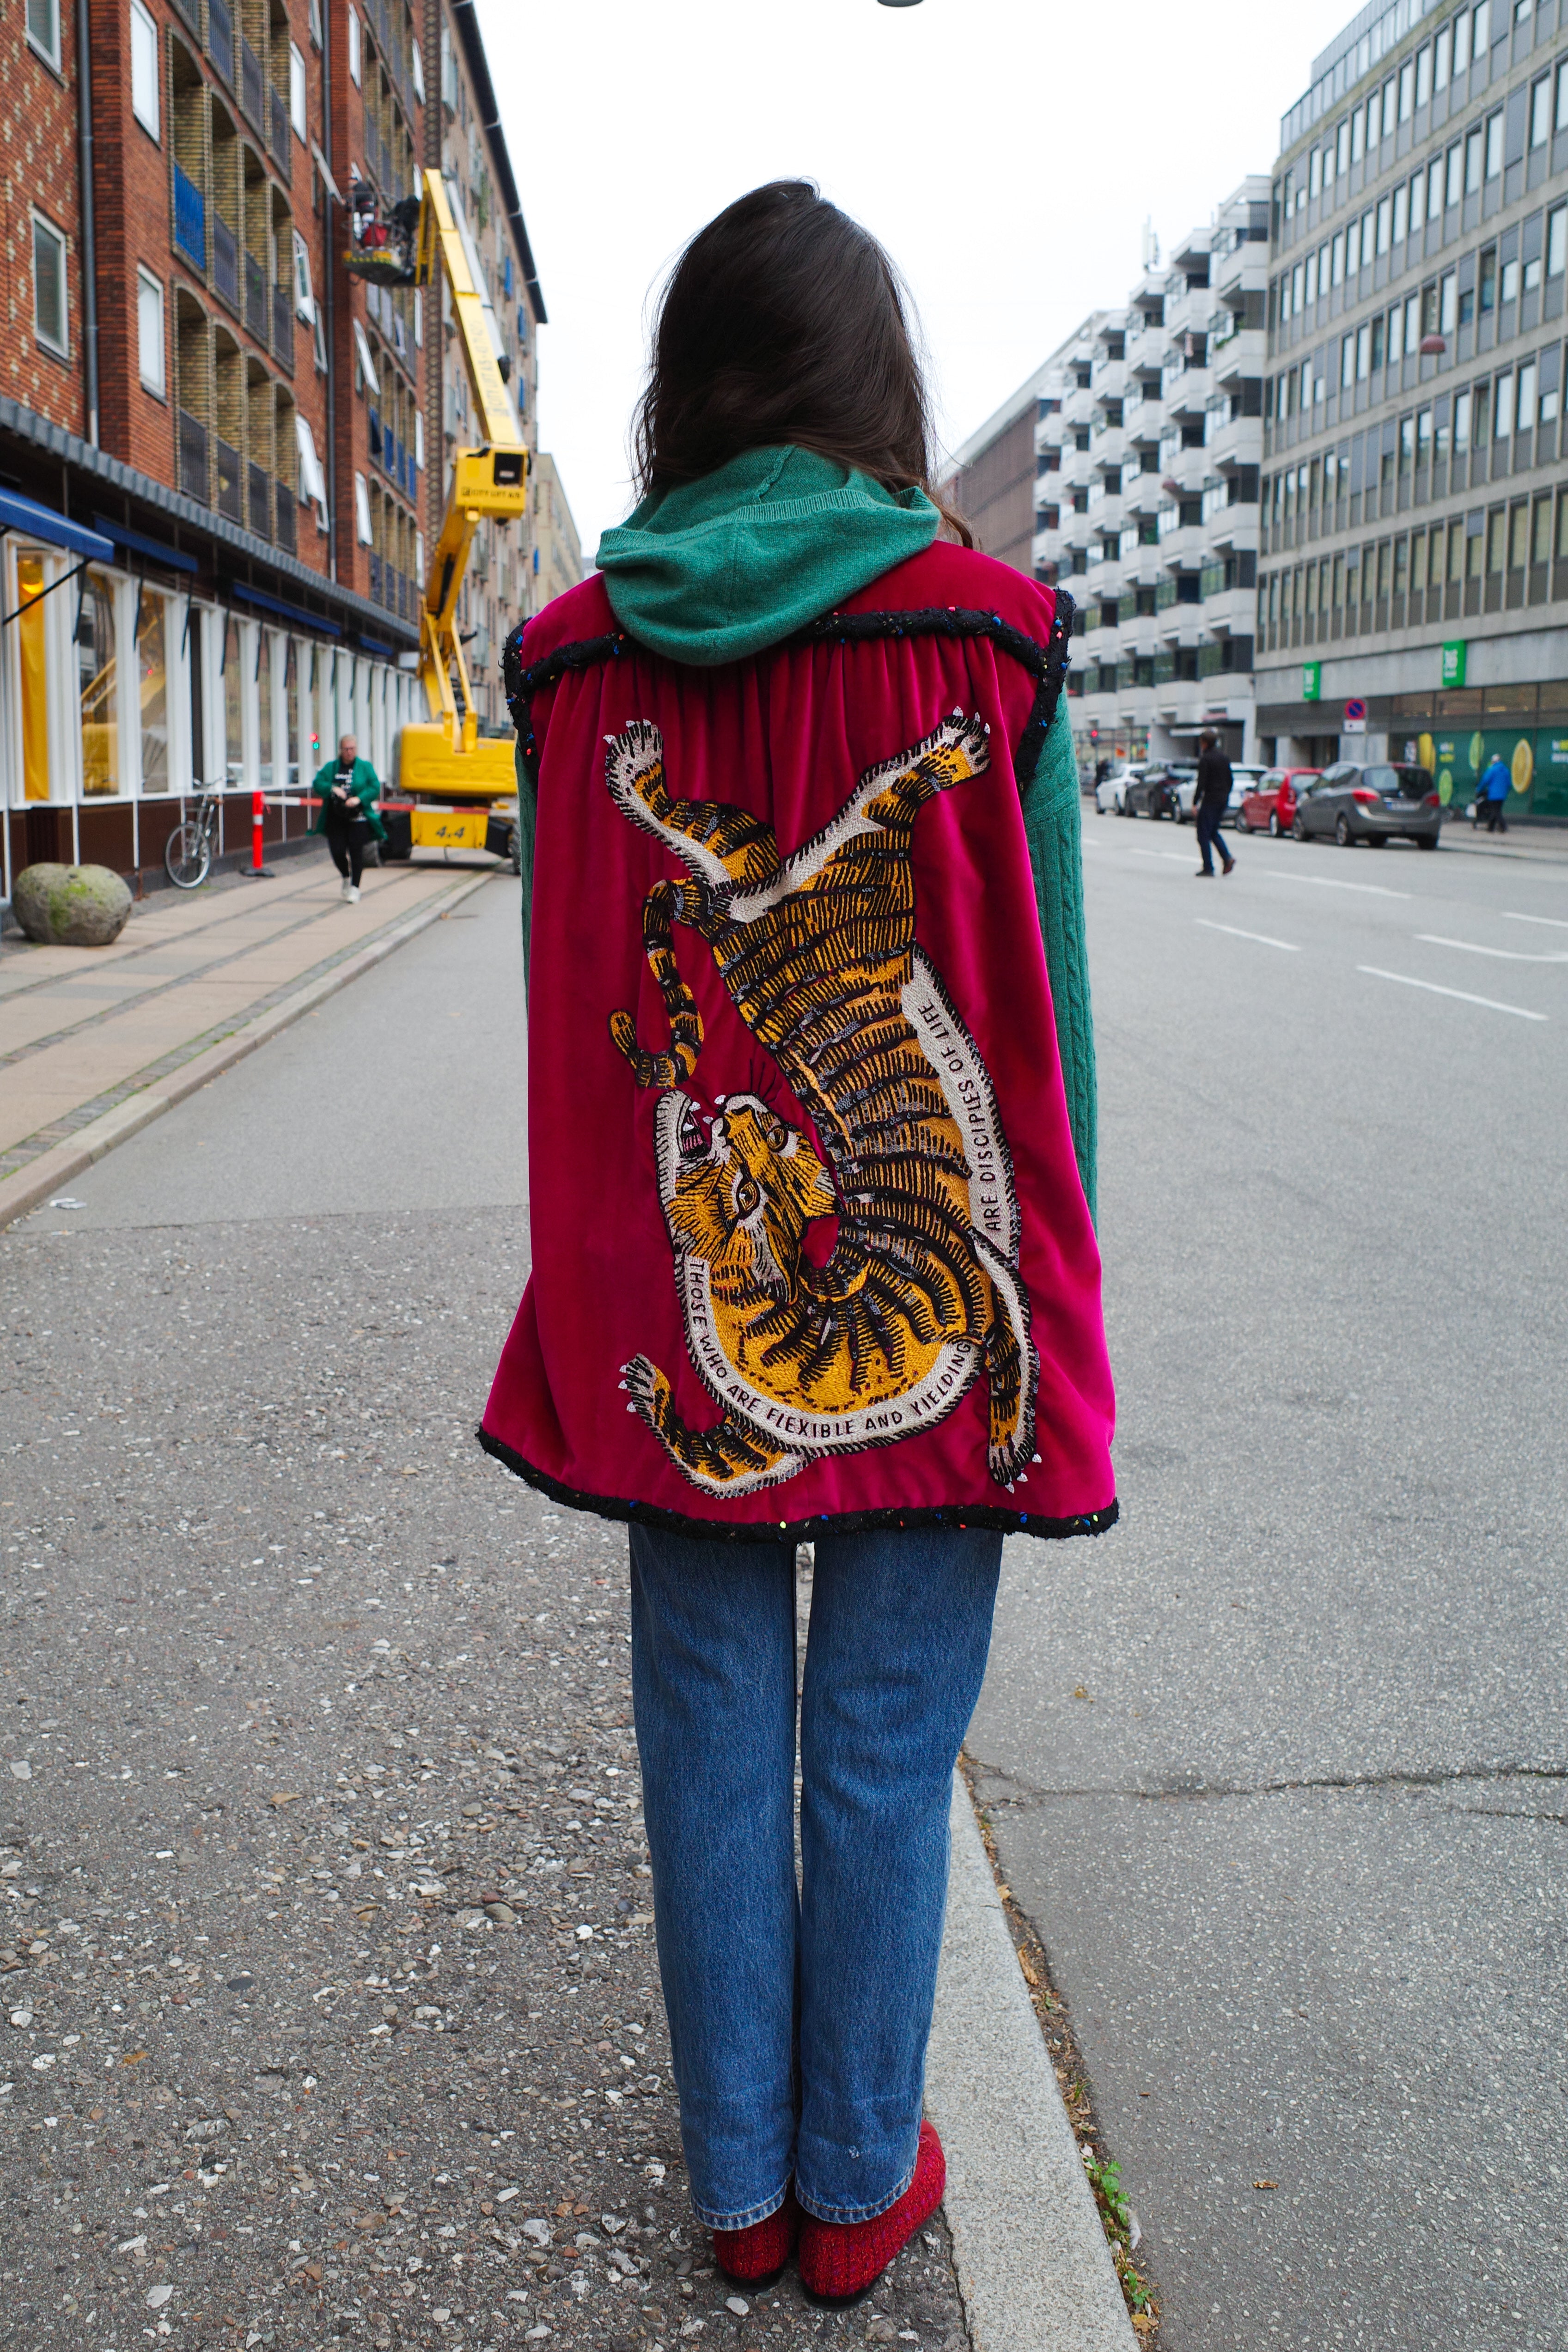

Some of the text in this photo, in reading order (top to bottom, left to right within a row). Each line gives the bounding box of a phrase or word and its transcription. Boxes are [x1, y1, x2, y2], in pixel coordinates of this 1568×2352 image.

[917, 999, 1002, 1231] ARE DISCIPLES OF LIFE
[689, 1261, 971, 1438] THOSE WHO ARE FLEXIBLE AND YIELDING
